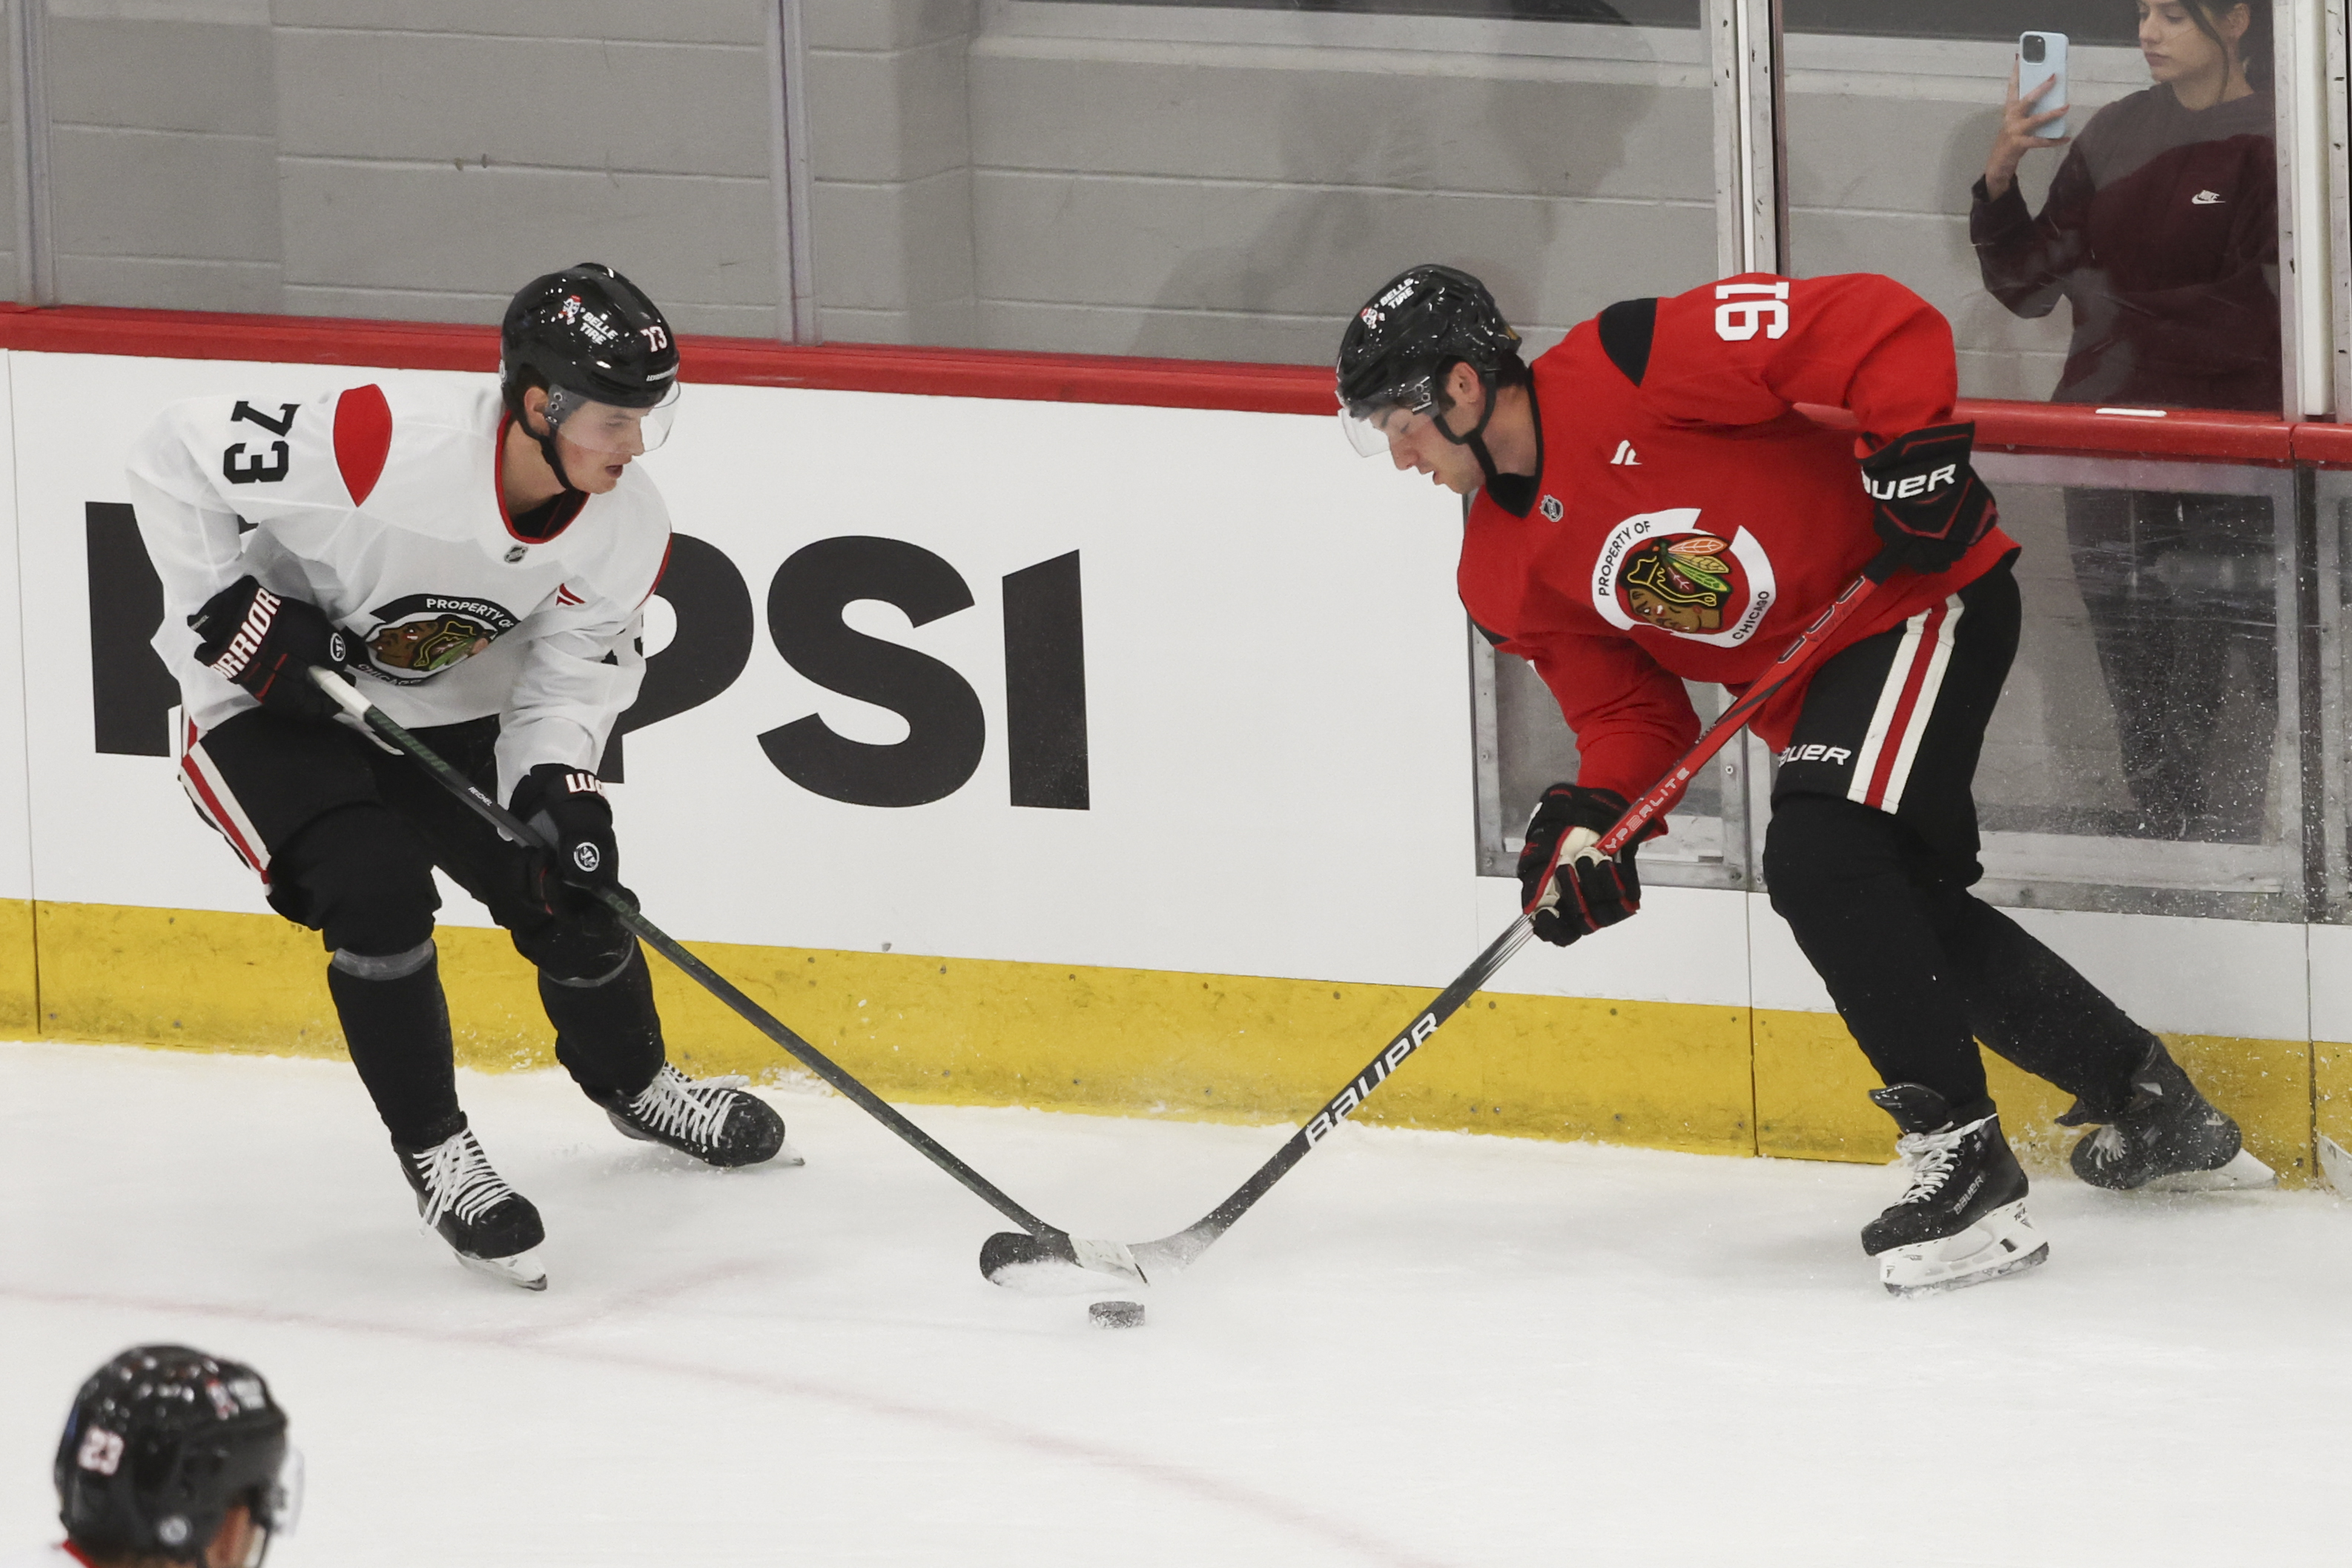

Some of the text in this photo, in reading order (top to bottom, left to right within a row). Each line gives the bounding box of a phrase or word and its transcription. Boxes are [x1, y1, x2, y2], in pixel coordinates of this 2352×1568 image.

[1379, 277, 1414, 307] BELLE
[1387, 286, 1415, 309] TIRE
[582, 311, 619, 340] BELLE
[1715, 281, 1789, 341] 91
[579, 322, 607, 345] TIRE
[640, 325, 668, 352] 73
[223, 400, 302, 484] 73
[1598, 520, 1651, 596] PROPERTY OF
[426, 598, 505, 621] PROPERTY
[1732, 590, 1770, 640] CHICAGO
[604, 893, 664, 941] COVERT
[1952, 1174, 1985, 1216] BAUER
